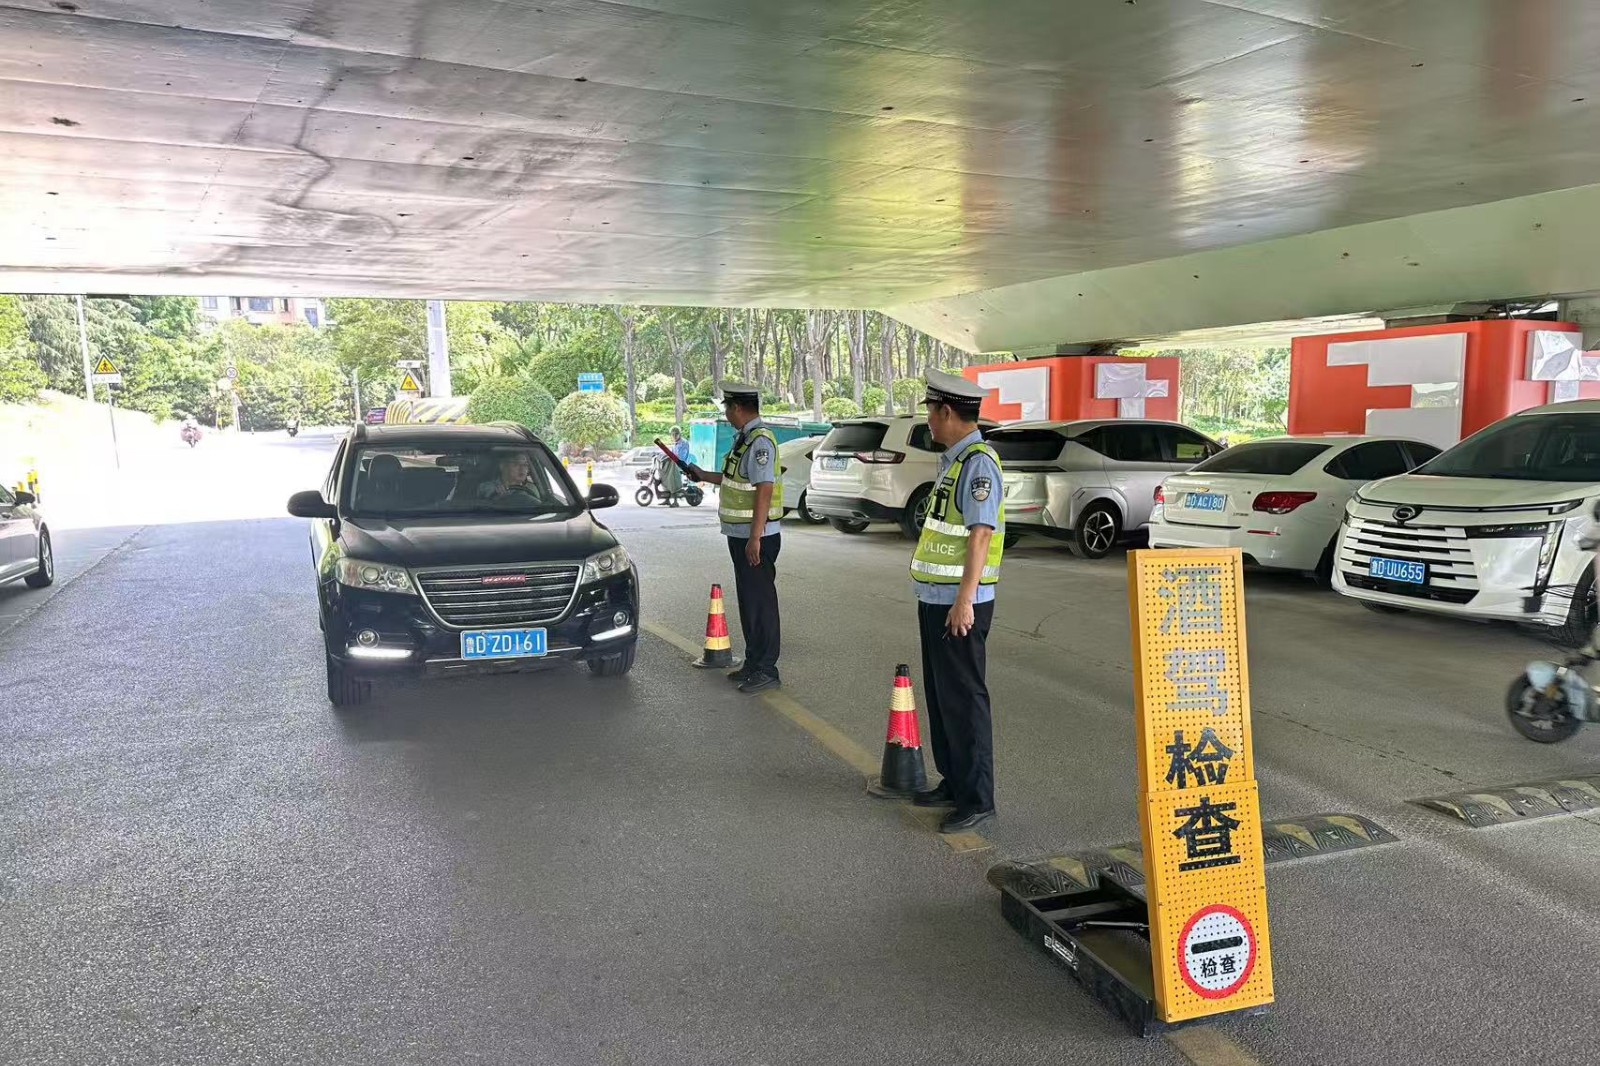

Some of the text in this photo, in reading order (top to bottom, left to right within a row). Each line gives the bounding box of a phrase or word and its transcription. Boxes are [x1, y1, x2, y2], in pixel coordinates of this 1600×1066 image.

[922, 541, 956, 556] OLICE
[1158, 567, 1241, 872] 酒驾检查
[1201, 953, 1237, 979] 检查
